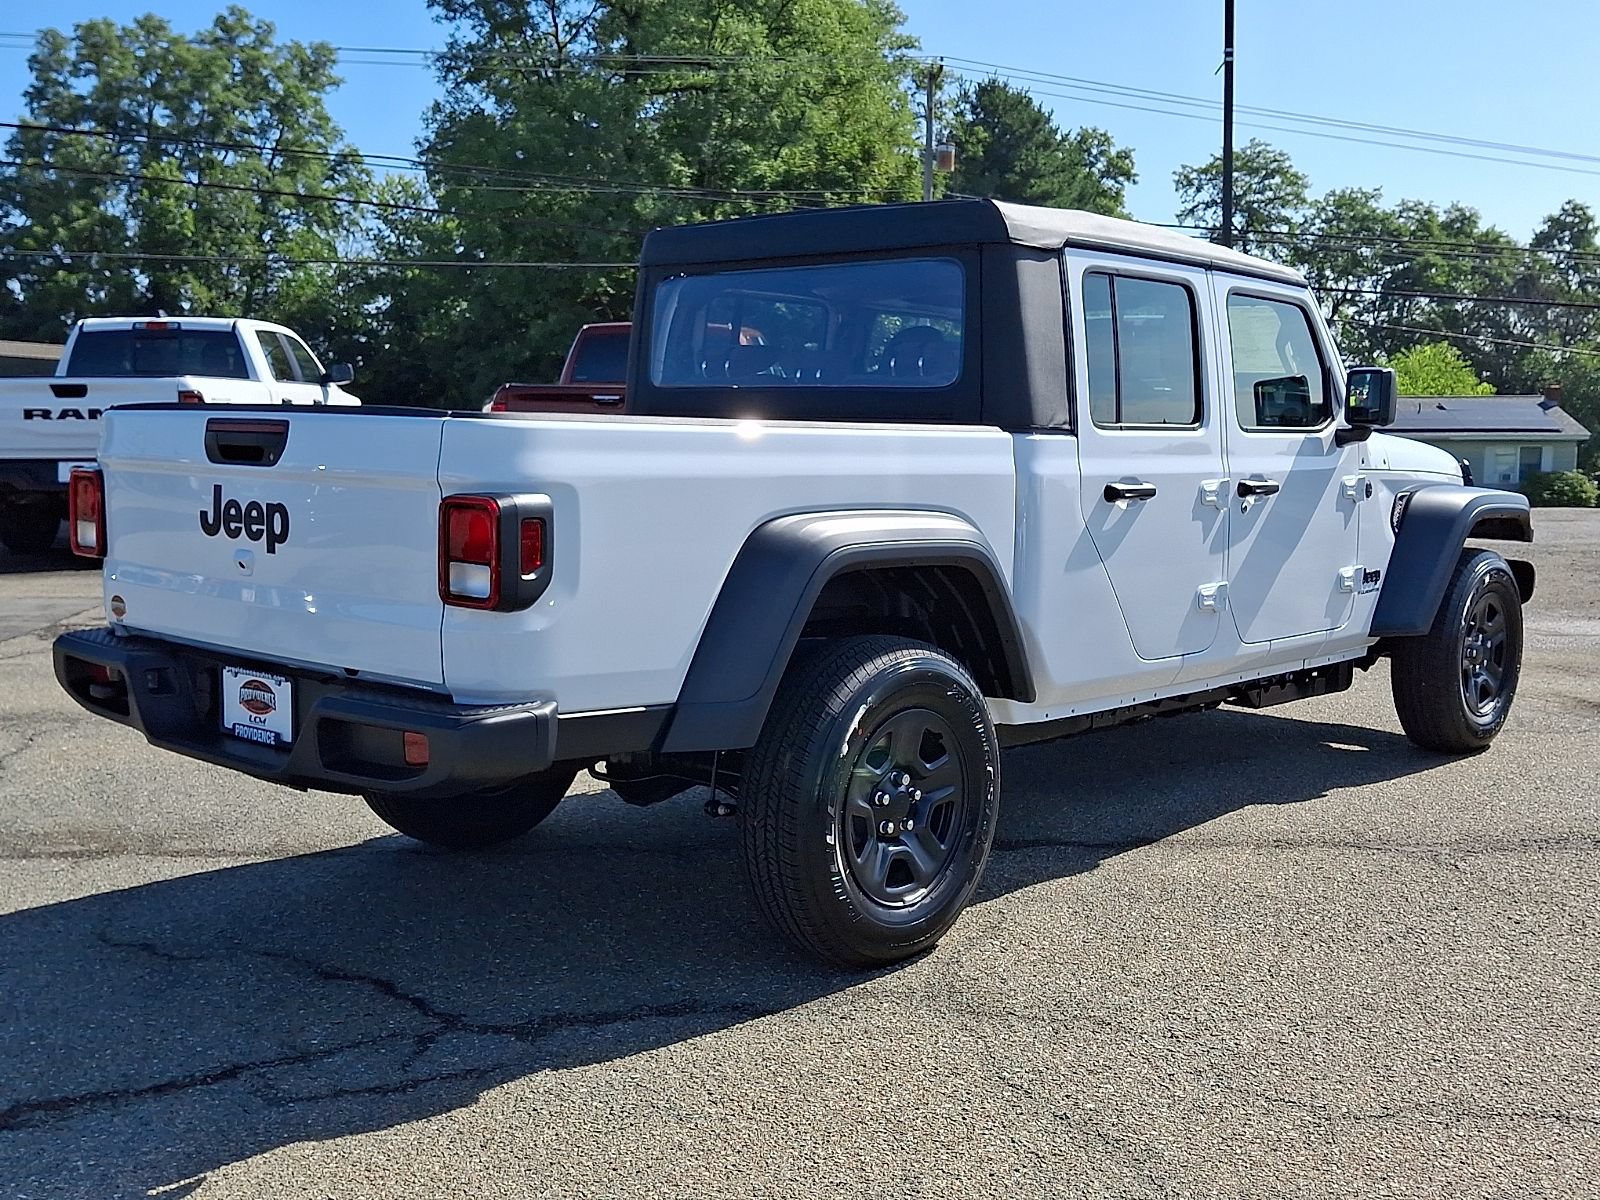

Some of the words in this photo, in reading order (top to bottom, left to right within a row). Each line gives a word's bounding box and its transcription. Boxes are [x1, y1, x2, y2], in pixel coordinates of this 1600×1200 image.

[199, 484, 290, 554] Jeep
[1362, 567, 1381, 586] Jeep
[240, 687, 276, 710] PROVIDENCE
[235, 723, 276, 745] PROVIDENCE
